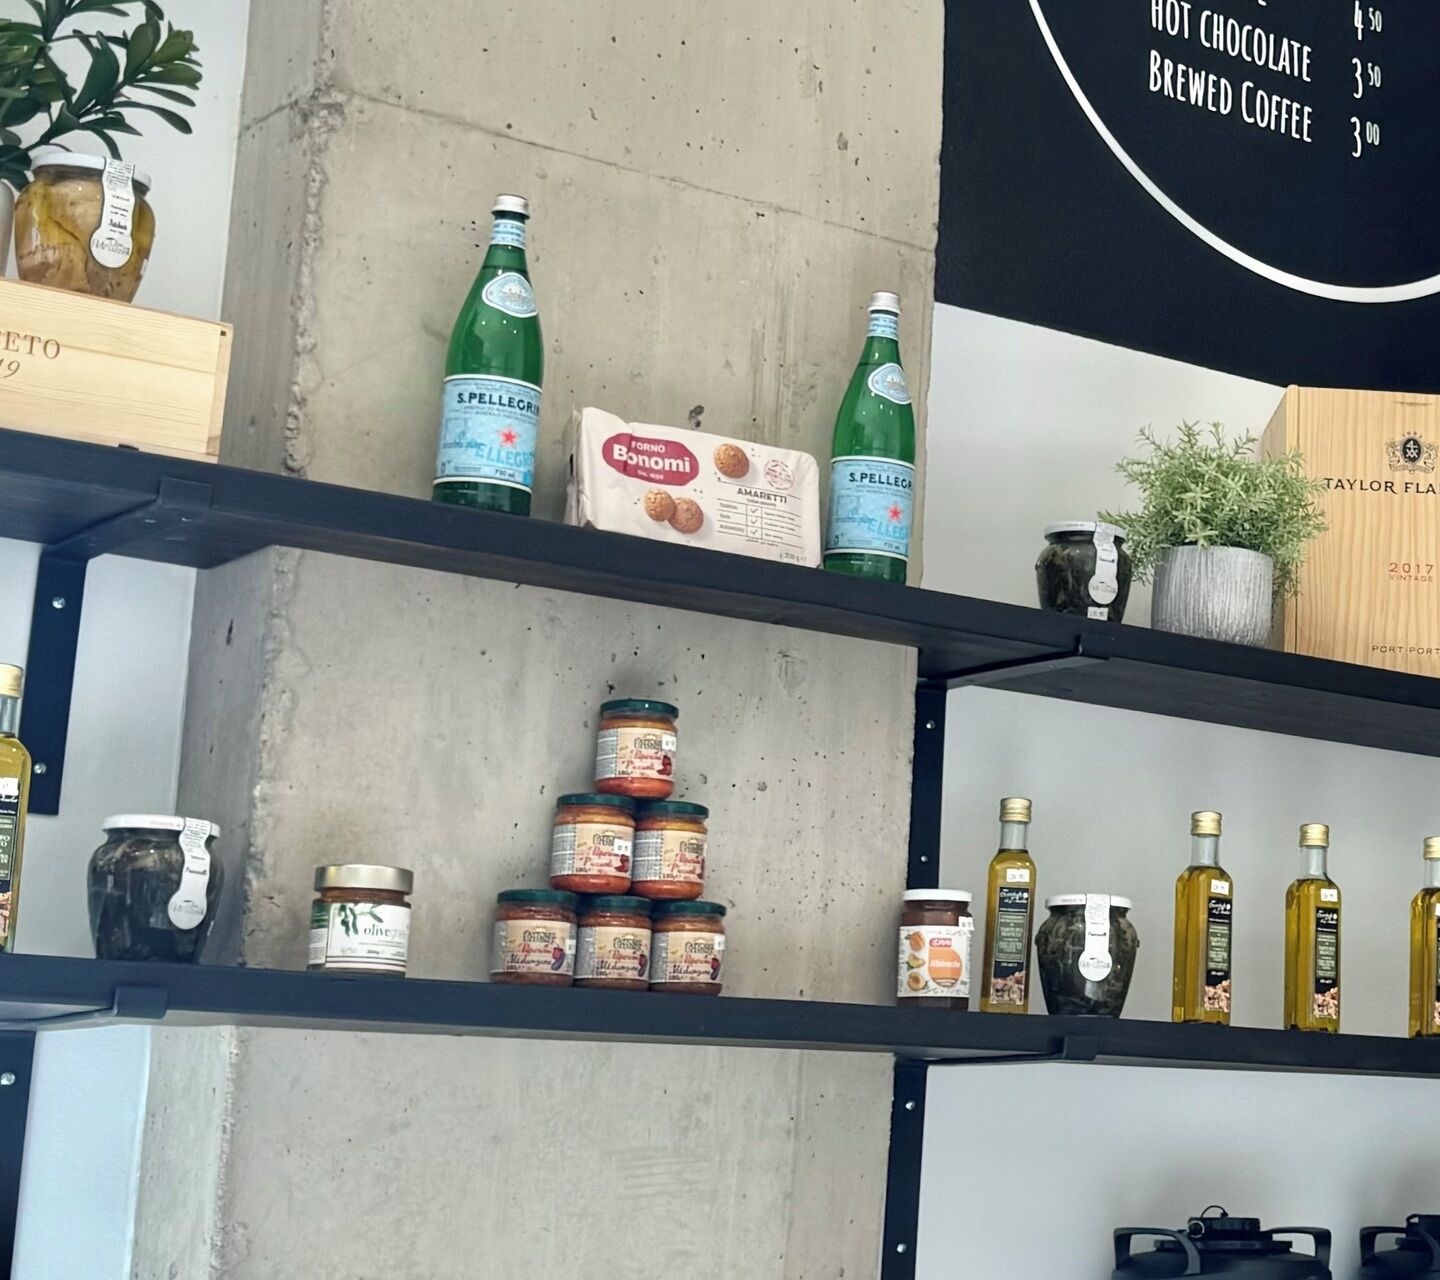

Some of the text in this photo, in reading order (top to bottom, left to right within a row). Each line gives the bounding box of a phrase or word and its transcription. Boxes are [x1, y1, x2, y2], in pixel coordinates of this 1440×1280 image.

[1199, 8, 1312, 83] CHOCOLATE
[1149, 49, 1233, 116] BREWED
[1240, 80, 1313, 144] COFFEE
[0, 329, 60, 360] ETO
[612, 443, 692, 474] Bonomi
[736, 487, 788, 504] AMARETTI
[1323, 477, 1398, 495] TAYLOR
[1388, 562, 1434, 575] 2017
[1388, 574, 1434, 583] VINTAGE
